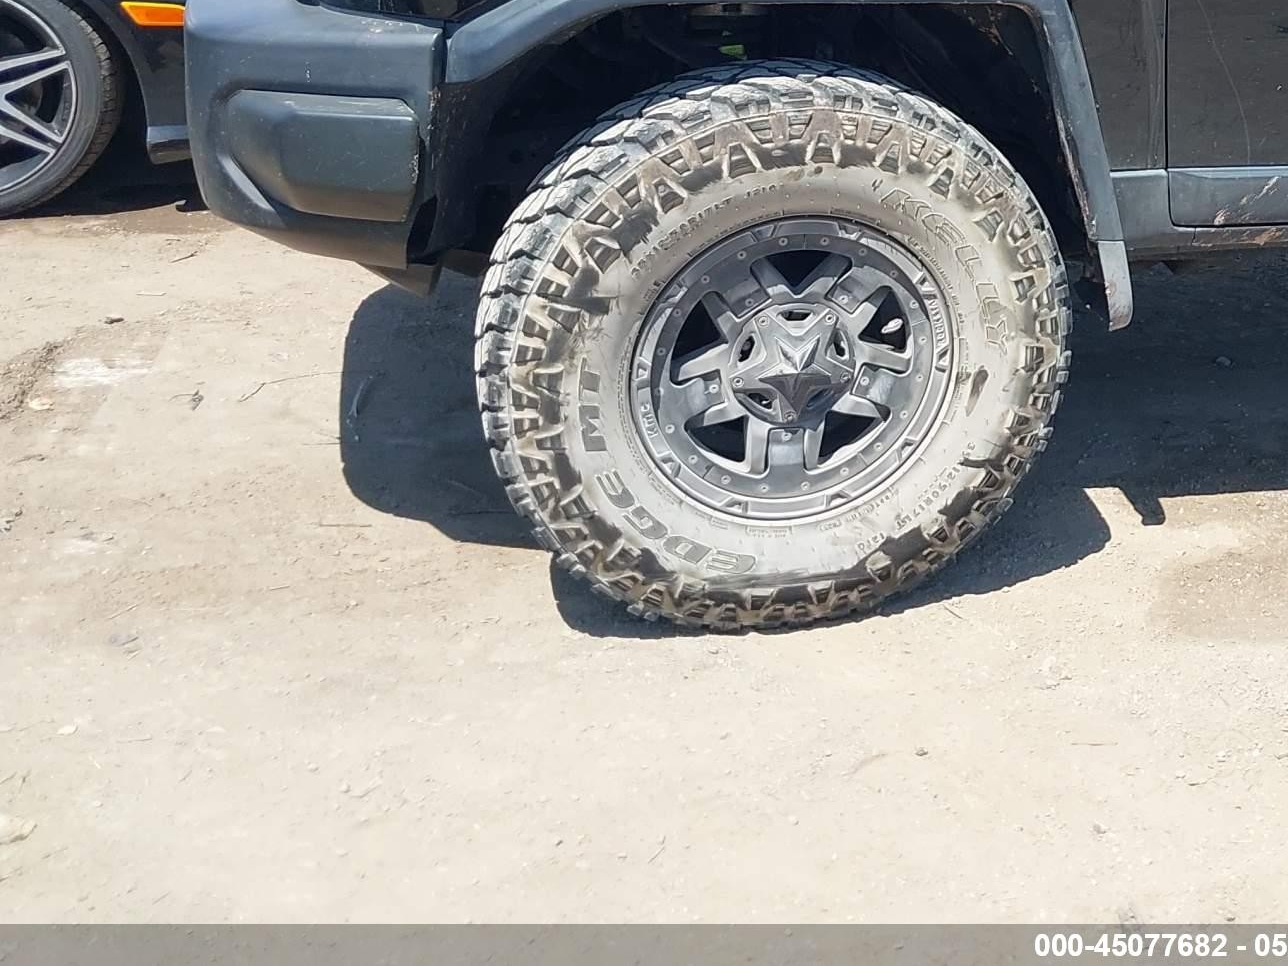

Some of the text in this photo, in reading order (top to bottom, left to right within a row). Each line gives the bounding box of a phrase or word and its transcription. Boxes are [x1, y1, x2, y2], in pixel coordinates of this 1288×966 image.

[879, 188, 1007, 355] KELLY
[578, 356, 756, 574] EDGE MT
